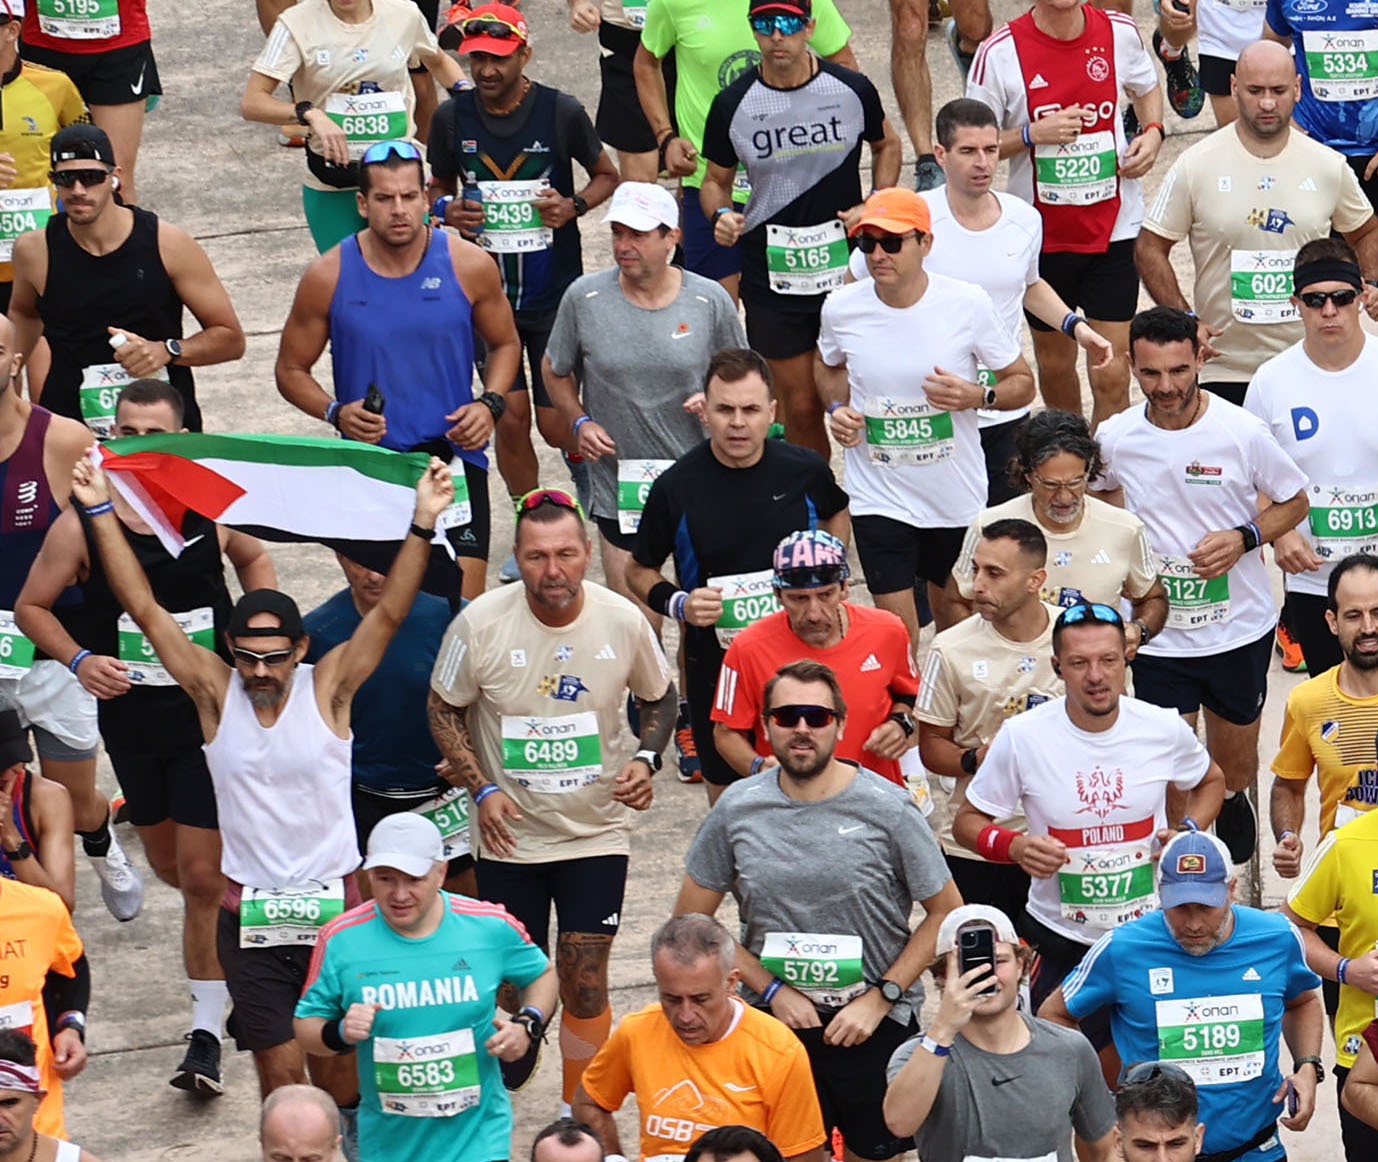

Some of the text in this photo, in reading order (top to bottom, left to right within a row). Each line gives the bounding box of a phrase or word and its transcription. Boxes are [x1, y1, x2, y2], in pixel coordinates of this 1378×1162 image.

[1324, 53, 1368, 73] 5334
[342, 115, 389, 135] 6838
[1055, 155, 1101, 178] 5220
[0, 212, 37, 232] 504
[486, 202, 533, 223] 5439
[784, 246, 830, 265] 5165
[882, 415, 933, 439] 5845
[1328, 506, 1377, 529] 6913
[523, 739, 579, 763] 6489
[1081, 824, 1124, 844] POLAND
[1081, 873, 1133, 897] 5377
[264, 899, 320, 920] 6596
[784, 961, 839, 983] 5792
[362, 975, 477, 1010] ROMANIA
[1183, 1025, 1239, 1049] 5189
[398, 1061, 454, 1086] 6583
